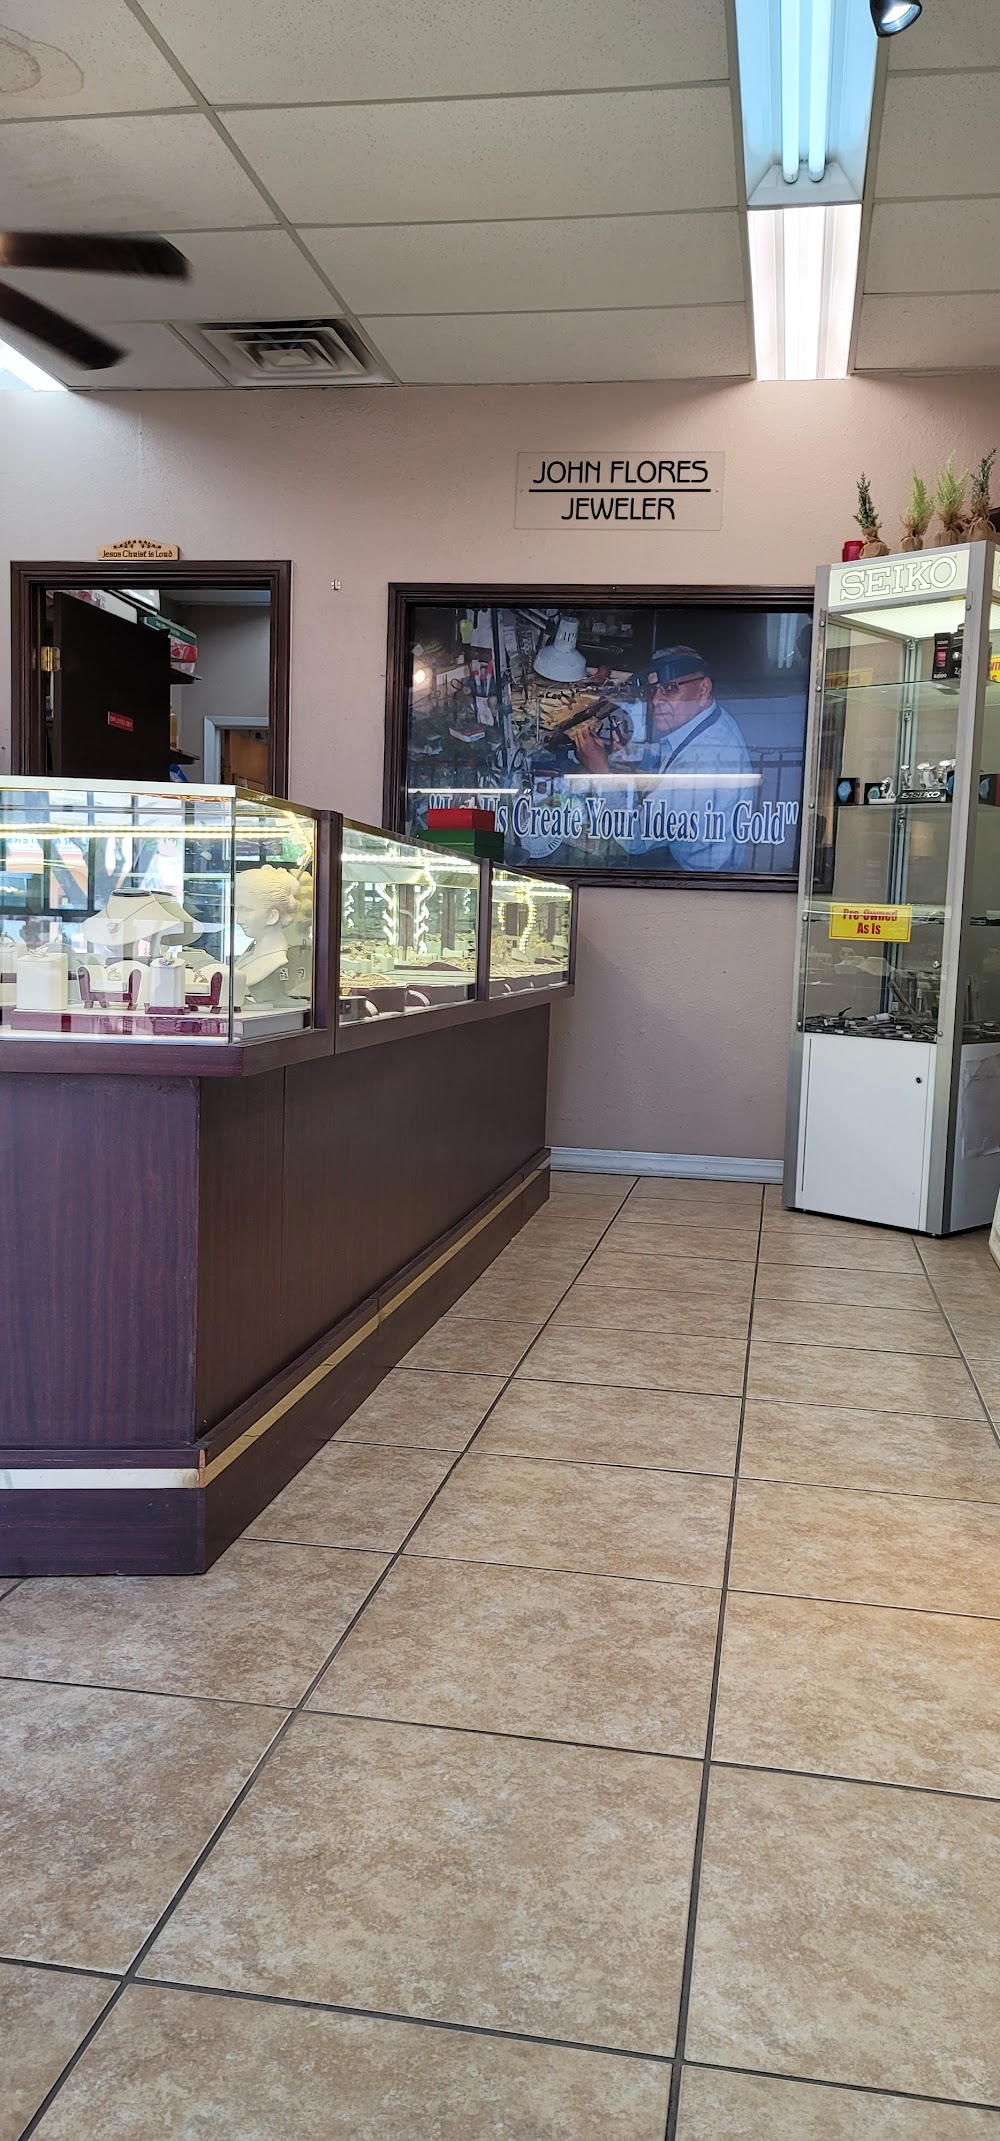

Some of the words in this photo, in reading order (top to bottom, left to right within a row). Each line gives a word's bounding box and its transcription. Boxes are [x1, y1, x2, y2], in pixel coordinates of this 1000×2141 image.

[533, 461, 601, 484] JOHN
[610, 460, 709, 484] FLORES
[561, 498, 676, 520] JEWELER
[102, 550, 122, 558] Jesus
[123, 550, 147, 558] Christ
[155, 550, 173, 558] Lord
[840, 556, 958, 601] SEIKO
[900, 791, 941, 799] SEIKO
[513, 795, 583, 842] Create
[586, 797, 638, 842] Your
[642, 798, 700, 843] Ideas
[702, 799, 727, 843] in
[731, 800, 800, 845] Gold"
[842, 908, 899, 922] Pre-Owned
[857, 922, 870, 934] As
[871, 923, 881, 935] Is
